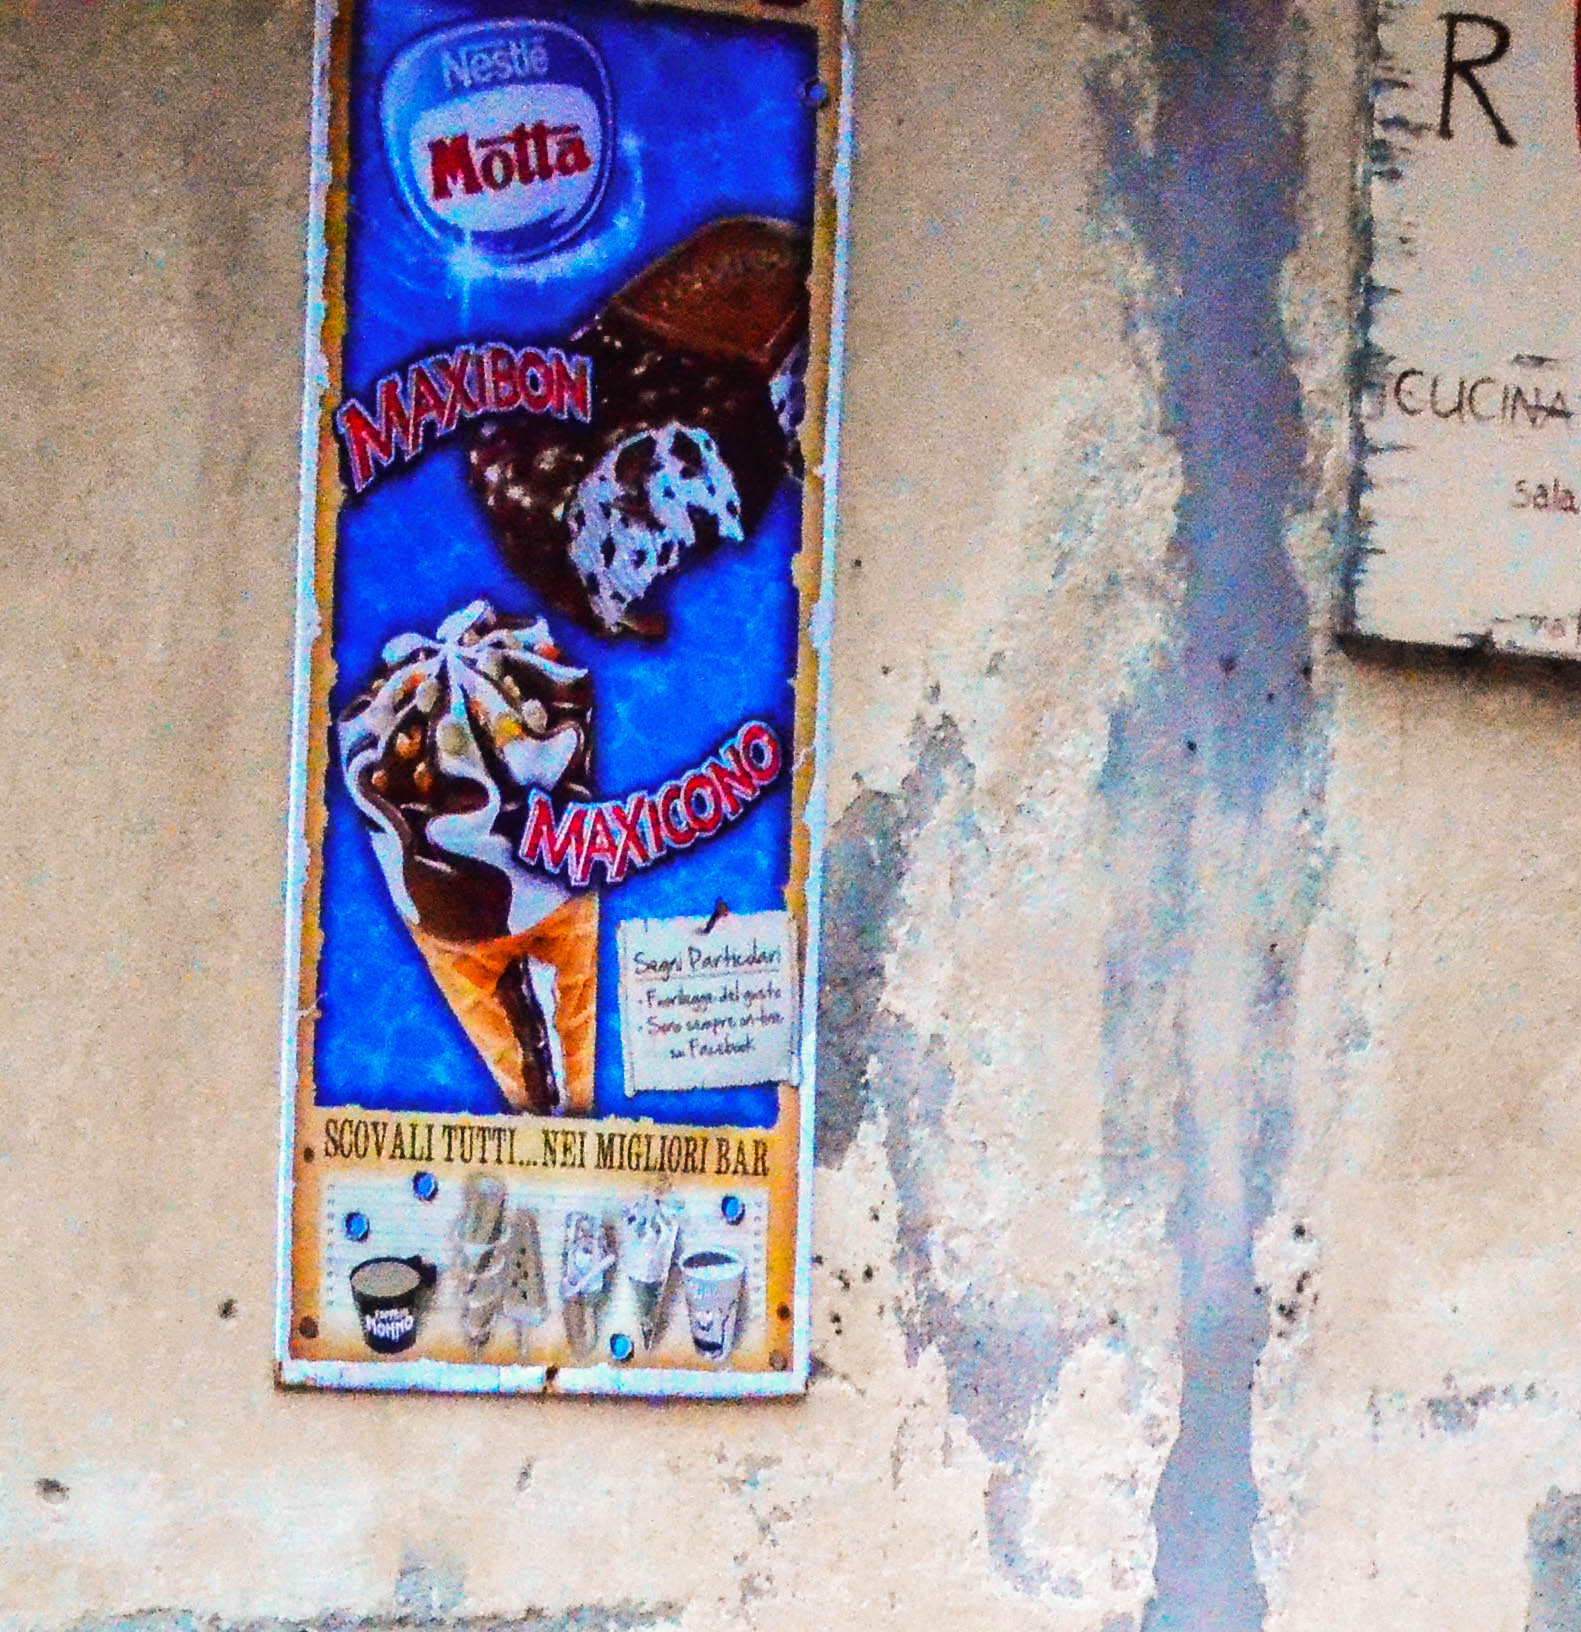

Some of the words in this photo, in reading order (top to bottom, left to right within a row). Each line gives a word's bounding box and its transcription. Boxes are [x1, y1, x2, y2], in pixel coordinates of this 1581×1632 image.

[428, 120, 592, 200] Motta
[336, 342, 592, 492] MAXIBON
[1393, 367, 1574, 430] CUCINA
[519, 719, 782, 888] MAXICONO
[719, 979, 739, 1003] del
[324, 1118, 435, 1163] SCOVALI
[594, 1131, 711, 1174] MIGLIORI
[714, 1136, 770, 1177] BAR
